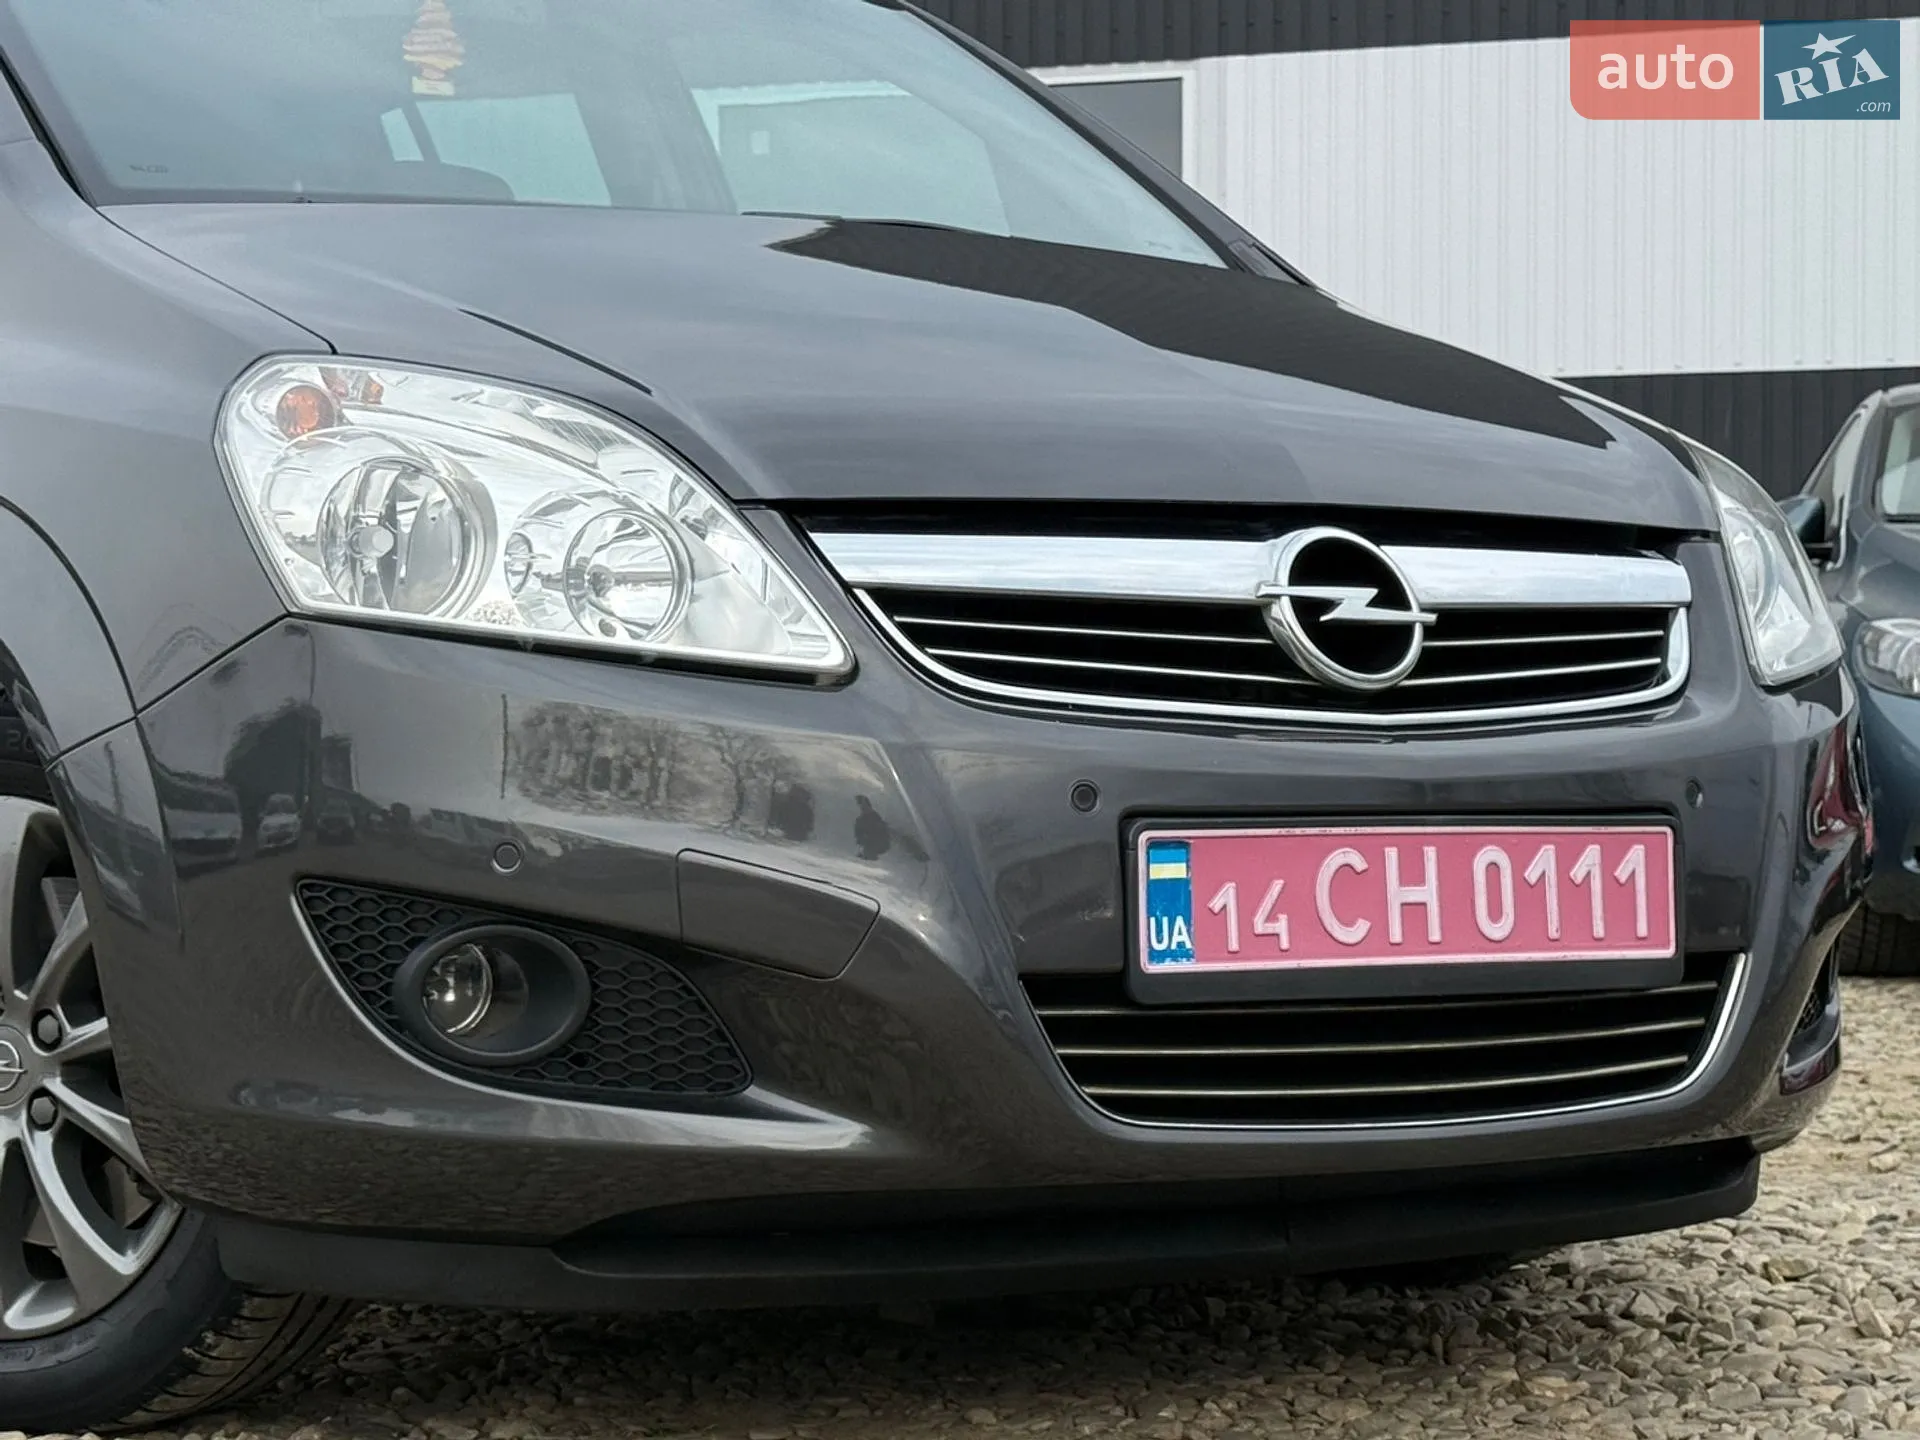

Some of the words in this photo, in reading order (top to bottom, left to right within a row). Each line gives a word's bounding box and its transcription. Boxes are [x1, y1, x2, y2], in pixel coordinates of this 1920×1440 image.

[1150, 915, 1193, 951] UA
[1207, 879, 1290, 953] 14
[1315, 846, 1442, 946] CH
[1473, 843, 1648, 943] 0111
